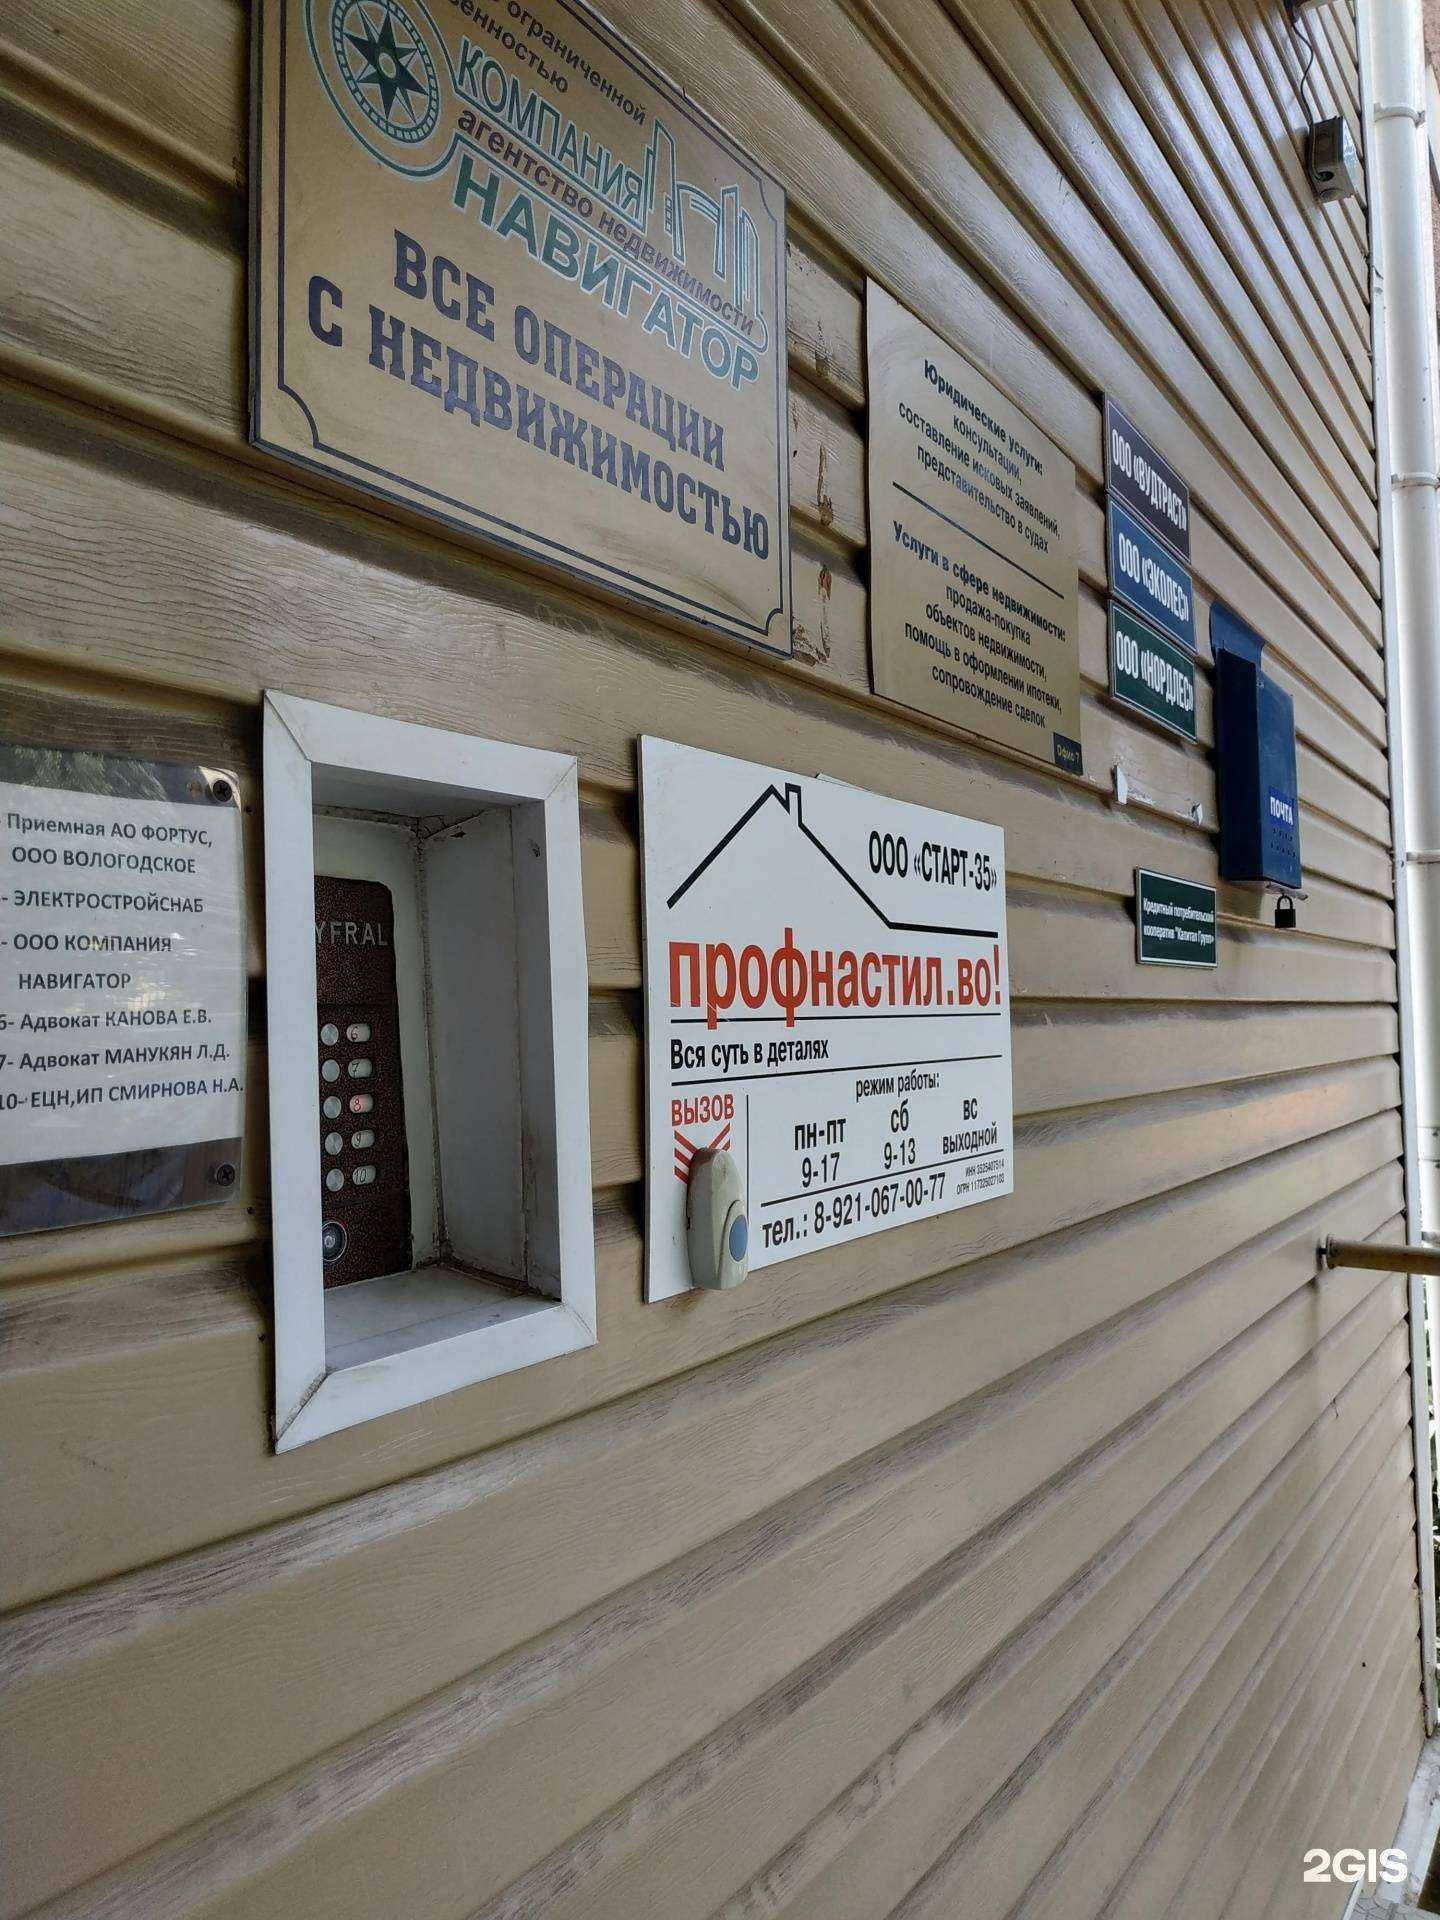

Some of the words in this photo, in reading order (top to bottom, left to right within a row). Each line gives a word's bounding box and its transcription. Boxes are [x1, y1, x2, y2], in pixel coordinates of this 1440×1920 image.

[507, 0, 647, 126] ограниченной
[456, 34, 645, 222] КОМПАНИЯ
[458, 109, 594, 218] агентство
[599, 210, 754, 336] недвижимости
[452, 151, 761, 391] НАВИГАТОР
[393, 228, 495, 342] ВСЕ
[514, 304, 725, 472] ОПЕРАЦИИ
[308, 275, 343, 347] С
[368, 303, 769, 561] НЕДВИЖИМОСТЬЮ
[924, 359, 1007, 443] Юридические
[1008, 434, 1043, 477] услуги:
[899, 402, 970, 467] составление
[972, 458, 1013, 500] исковых
[1015, 492, 1061, 541] заявлений,
[953, 415, 1022, 485] консультации,
[1111, 428, 1132, 478] ООО
[917, 444, 1016, 529] представительство
[1017, 520, 1023, 535] в
[1024, 526, 1049, 553] судах
[893, 520, 939, 567] Услуги
[941, 555, 950, 572] в
[952, 562, 989, 596] сфере
[992, 584, 1066, 644] недвижимости:
[1118, 532, 1140, 584] ООО
[926, 603, 976, 642] объектов
[978, 630, 1047, 682] недвижимости,
[946, 585, 1031, 645] продажа-покупка
[905, 622, 952, 659] помощь
[954, 645, 960, 662] в
[963, 651, 1025, 691] оформлении
[1026, 680, 1062, 714] ипотеки,
[1116, 630, 1139, 680] ООО
[932, 665, 1013, 715] сопровождение
[1015, 705, 1046, 729] сделок
[7, 812, 105, 836] Приемная
[110, 822, 136, 839] АО
[141, 826, 213, 848] ФОРТУС,
[1270, 796, 1293, 825] ПОЧТА
[12, 846, 57, 865] ООО
[63, 850, 196, 874] ВОЛОГОДСКОЕ
[868, 829, 908, 878] ООО
[913, 841, 997, 892] «СТАРТ-35»
[14, 889, 204, 913] ЭЛЕКТРОСТРОЙСНАБ
[14, 933, 59, 951] ООО
[65, 934, 172, 952] КОМПАНИЯ
[19, 973, 131, 990] НАВИГАТОР
[668, 927, 1001, 1030] профнастил.во!
[20, 1013, 100, 1033] Адвокат
[105, 1009, 178, 1027] КАНОВА
[183, 1008, 212, 1025] Е.В.
[20, 1052, 100, 1072] Адвокат
[105, 1045, 192, 1065] МАНУКЯН
[196, 1043, 230, 1060] Л.Д.
[670, 1038, 706, 1070] Вся
[711, 1043, 749, 1073] суть
[754, 1042, 763, 1064] в
[767, 1039, 829, 1067] деталях
[109, 1080, 208, 1101] СМИРНОВА
[212, 1077, 244, 1093] Н.А.
[671, 1093, 735, 1126] ВЫЗОВ
[855, 1076, 894, 1103] режим
[897, 1068, 940, 1098] работы:
[890, 1099, 909, 1133] сб
[801, 1152, 840, 1188] 9-17
[883, 1137, 916, 1170] 9-13
[762, 1213, 808, 1248] тел.:
[814, 1172, 945, 1235] 8-921-067-00-77
